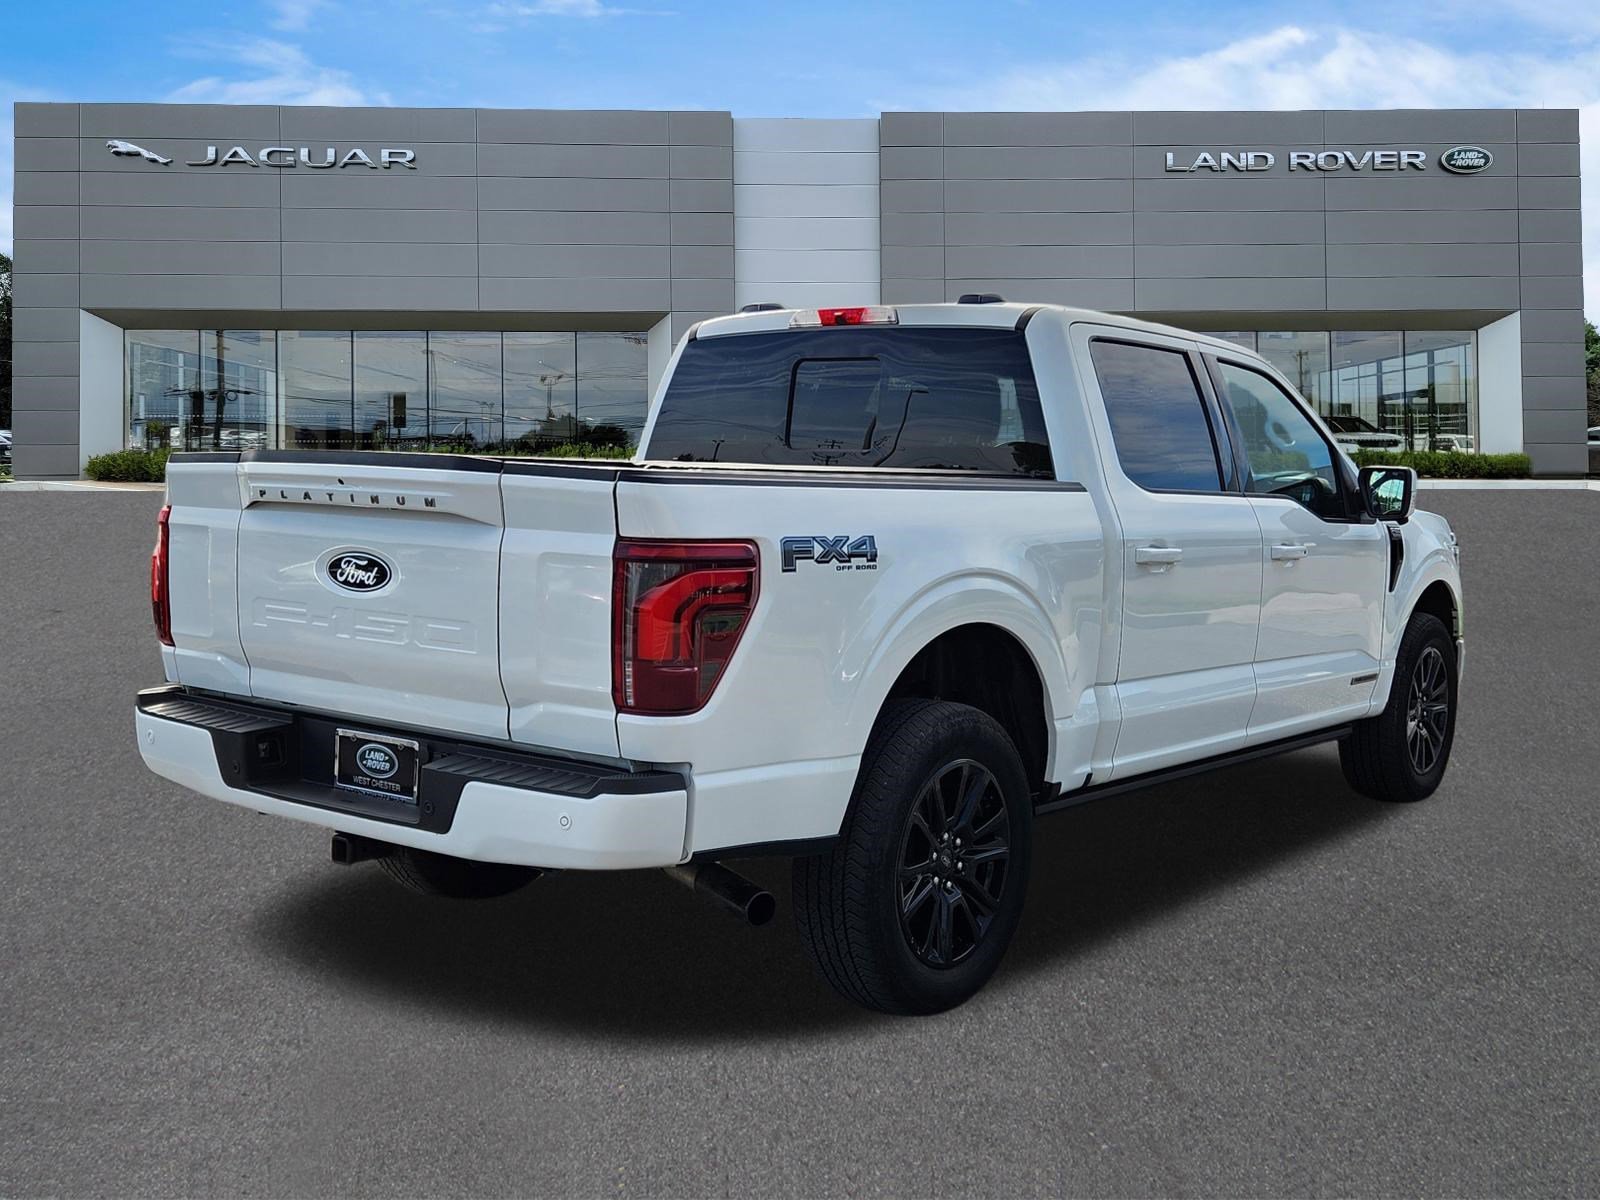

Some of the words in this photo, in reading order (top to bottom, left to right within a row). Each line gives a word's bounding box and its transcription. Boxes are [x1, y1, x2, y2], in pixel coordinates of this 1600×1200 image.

[185, 145, 417, 169] JAGUAR
[1165, 151, 1275, 172] LAND
[1289, 150, 1426, 171] ROVER
[1454, 151, 1478, 159] LAND
[1455, 158, 1485, 167] ROVER
[259, 489, 437, 508] PLATINUM
[781, 535, 878, 573] FX4
[336, 557, 377, 586] Ford
[252, 596, 479, 656] F-150
[365, 750, 385, 762] LAND
[366, 760, 391, 772] ROVER
[353, 775, 371, 787] WEST
[371, 779, 401, 793] CHESTER
